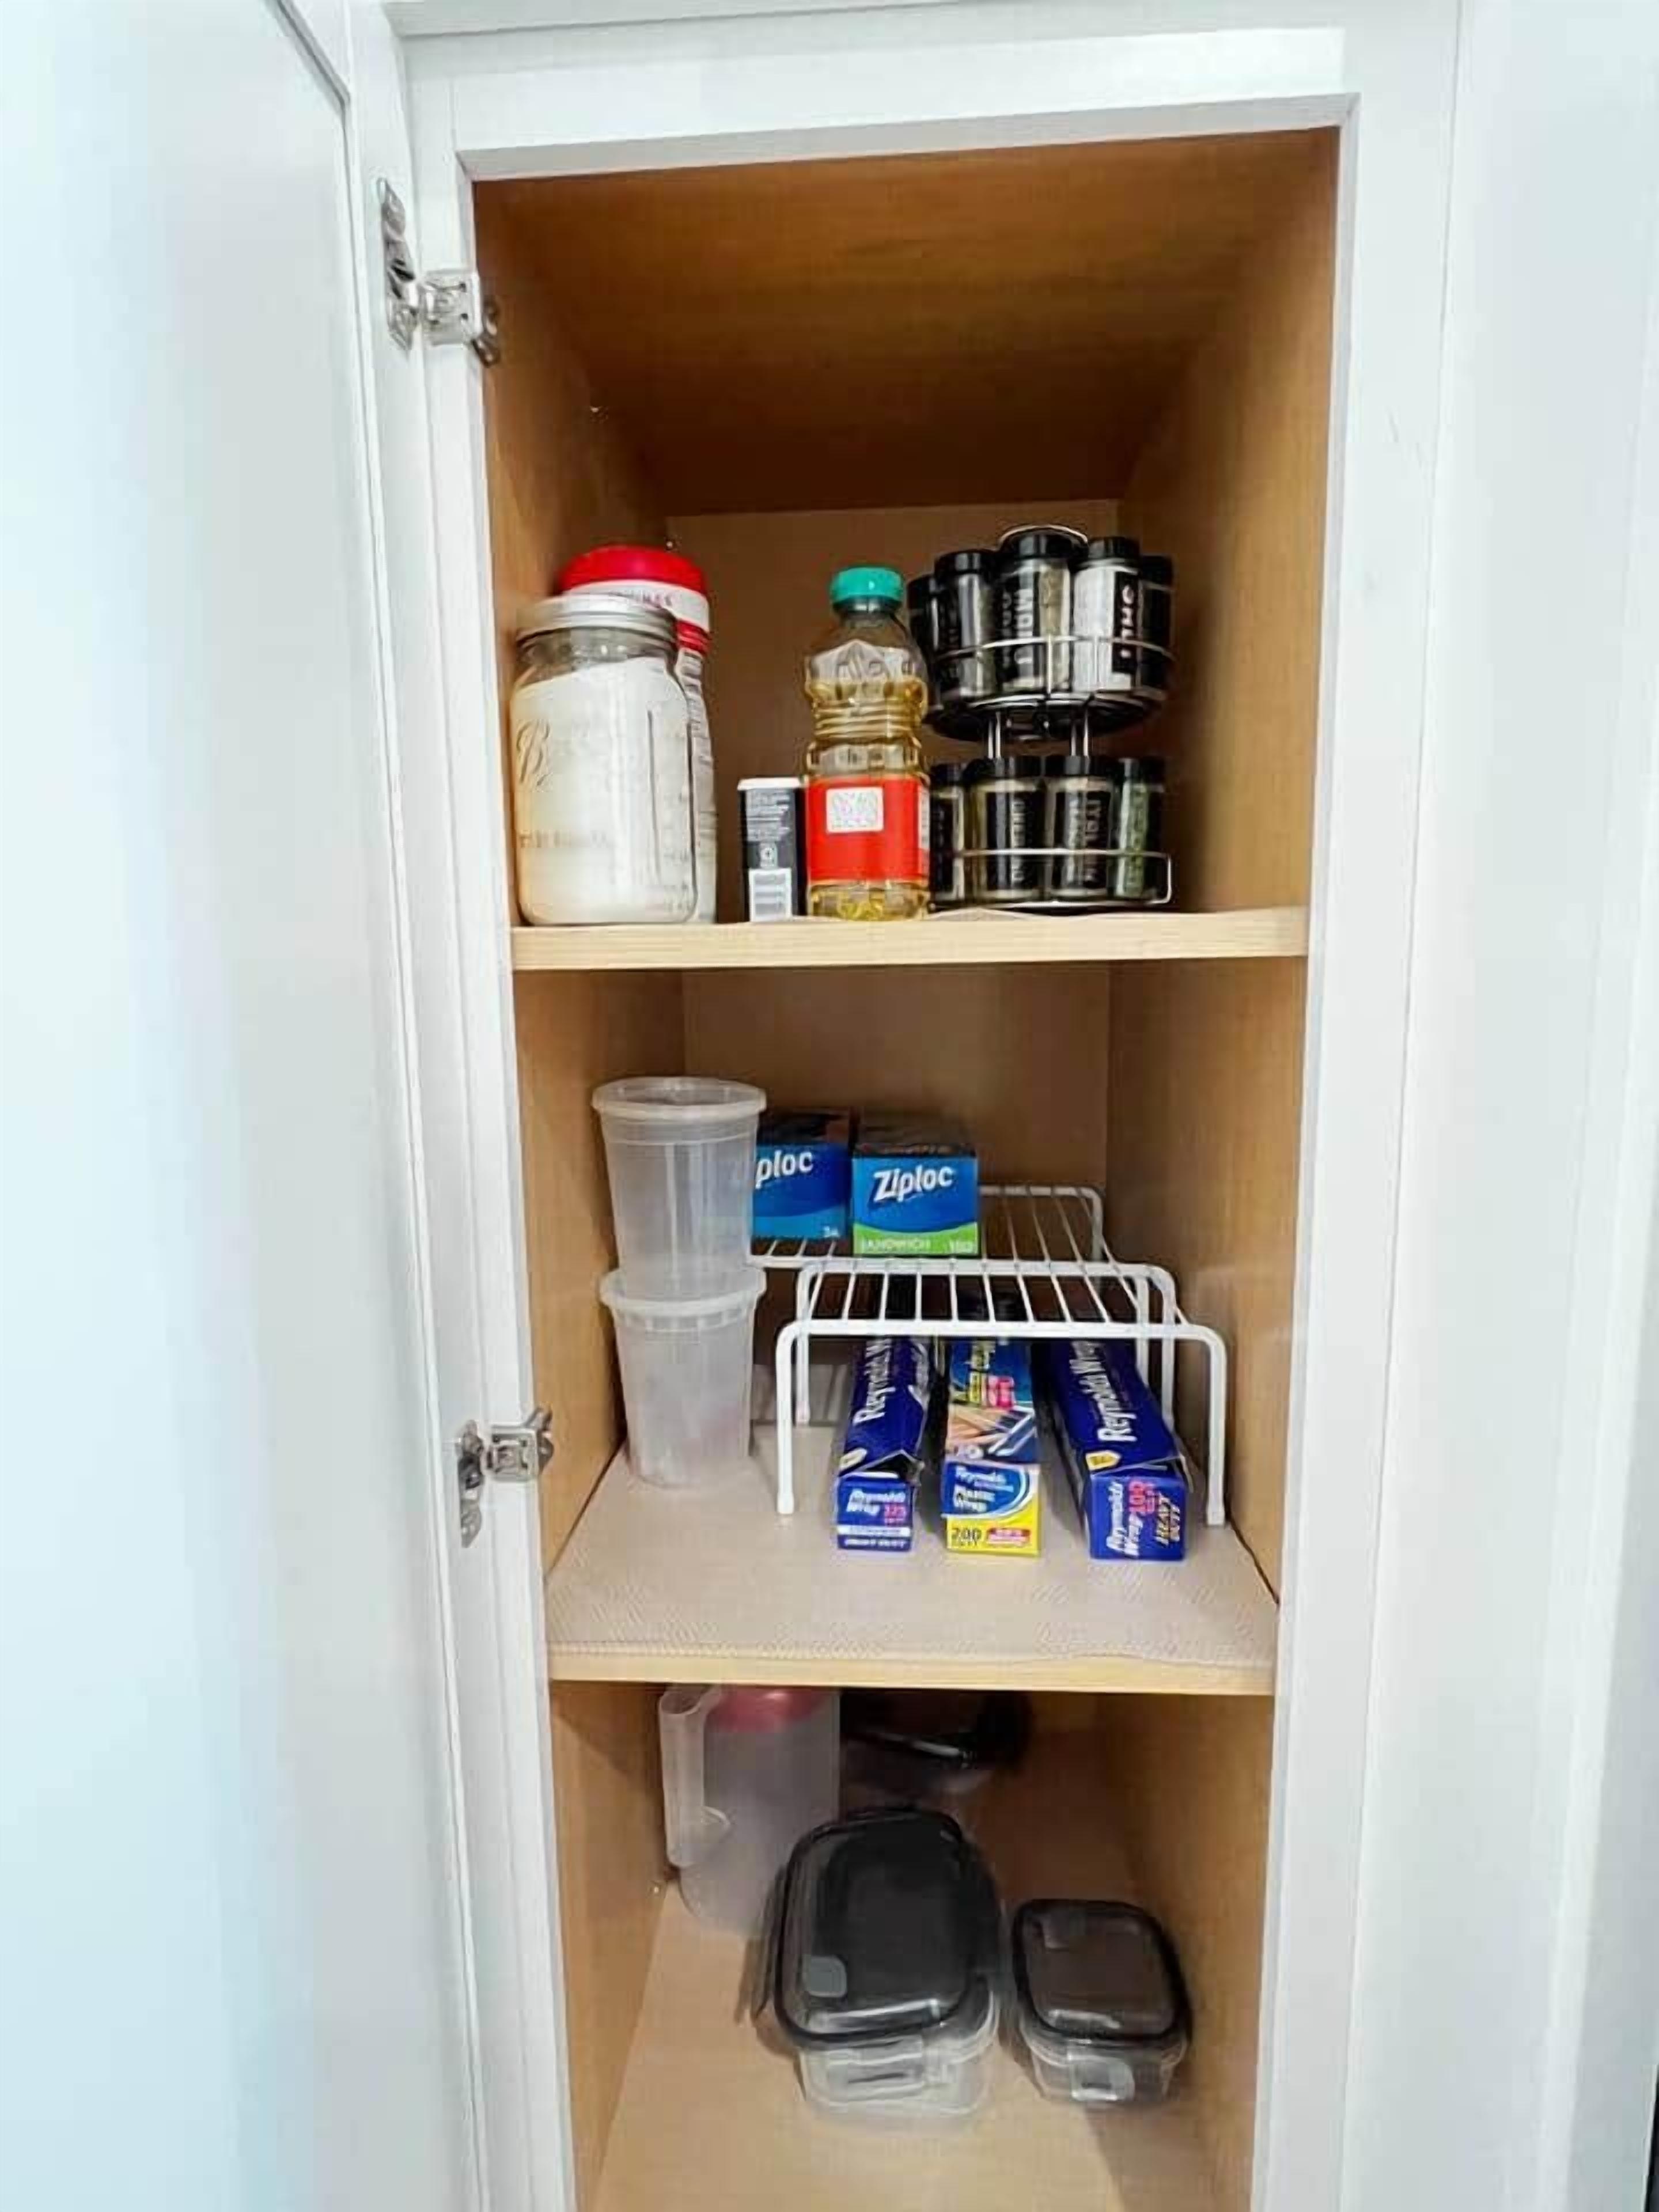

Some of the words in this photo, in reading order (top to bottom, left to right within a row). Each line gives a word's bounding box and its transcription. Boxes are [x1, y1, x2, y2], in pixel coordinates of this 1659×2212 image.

[755, 1151, 813, 1188] ploc
[873, 1165, 954, 1203] Ziploc
[1078, 1374, 1138, 1442] Reynolds
